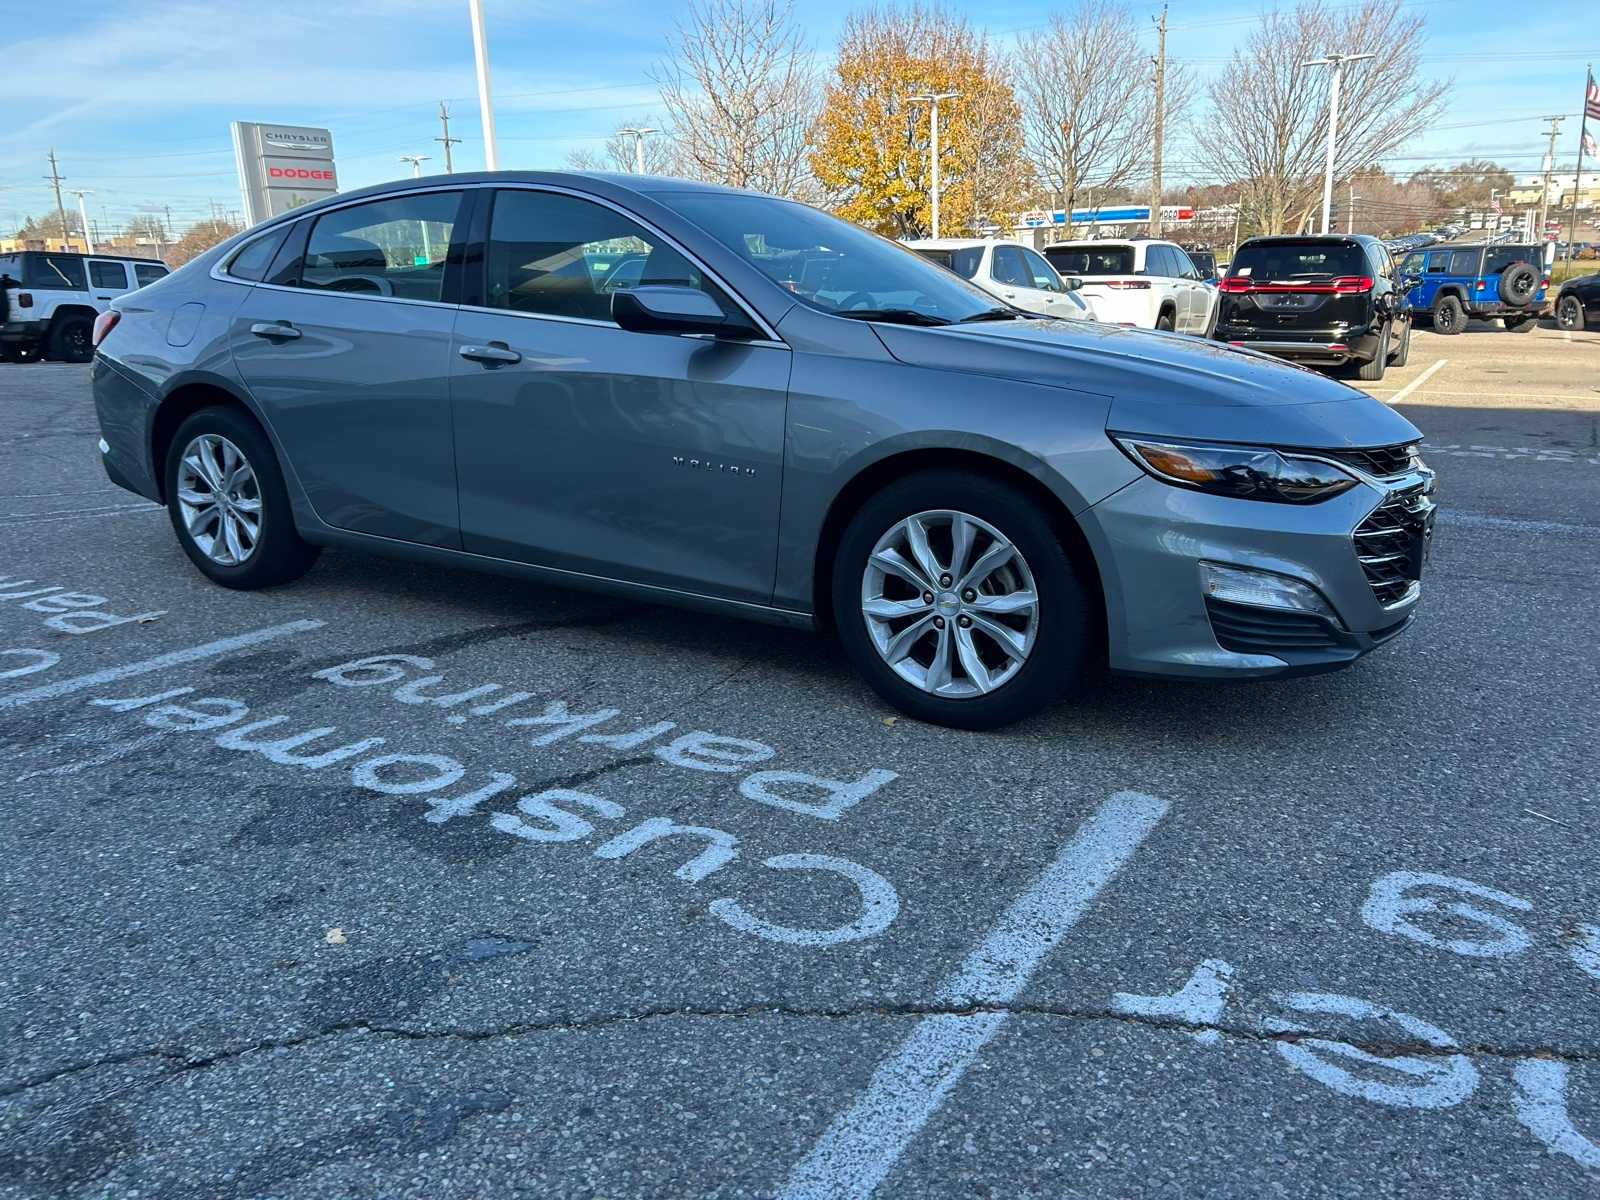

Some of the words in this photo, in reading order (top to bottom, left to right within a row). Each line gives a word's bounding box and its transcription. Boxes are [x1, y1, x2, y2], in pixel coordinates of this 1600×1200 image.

[265, 132, 327, 142] CHRYSLER
[269, 167, 334, 179] DODGE
[672, 456, 757, 477] MALIBU
[312, 653, 897, 821] Parking
[90, 686, 898, 946] Customer
